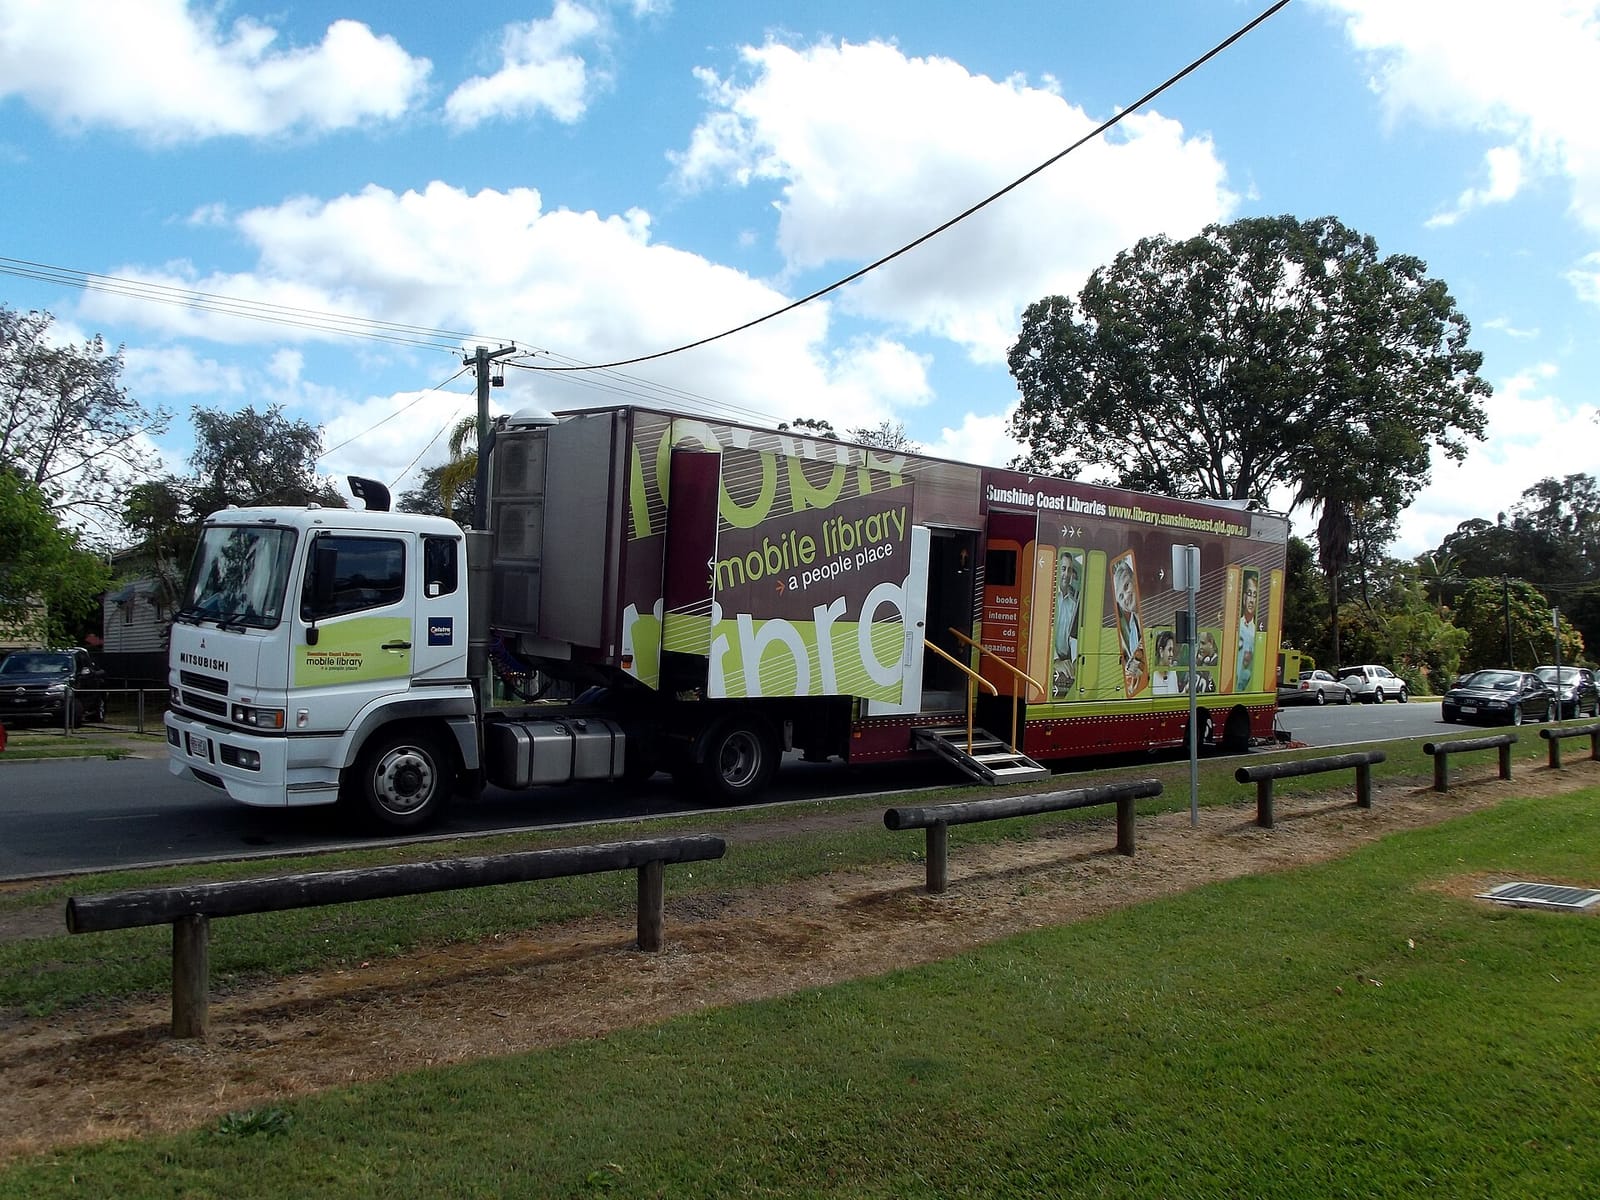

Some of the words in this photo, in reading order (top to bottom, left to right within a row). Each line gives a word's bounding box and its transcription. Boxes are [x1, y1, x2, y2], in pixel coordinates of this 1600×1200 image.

[986, 484, 1035, 506] Sunshine
[1036, 491, 1065, 510] Coast
[1066, 495, 1107, 516] Libraries
[1108, 505, 1248, 537] www.library.sunshinecoast.qld.gov.au
[715, 529, 817, 592] mobile
[822, 506, 907, 558] library
[787, 575, 799, 591] a
[801, 554, 852, 590] people
[855, 543, 893, 571] place
[995, 595, 1018, 605] books
[988, 611, 1017, 621] internet
[1002, 628, 1016, 637] cds
[180, 652, 229, 672] MITSUBISHI
[306, 657, 335, 666] mobile
[336, 657, 363, 668] library
